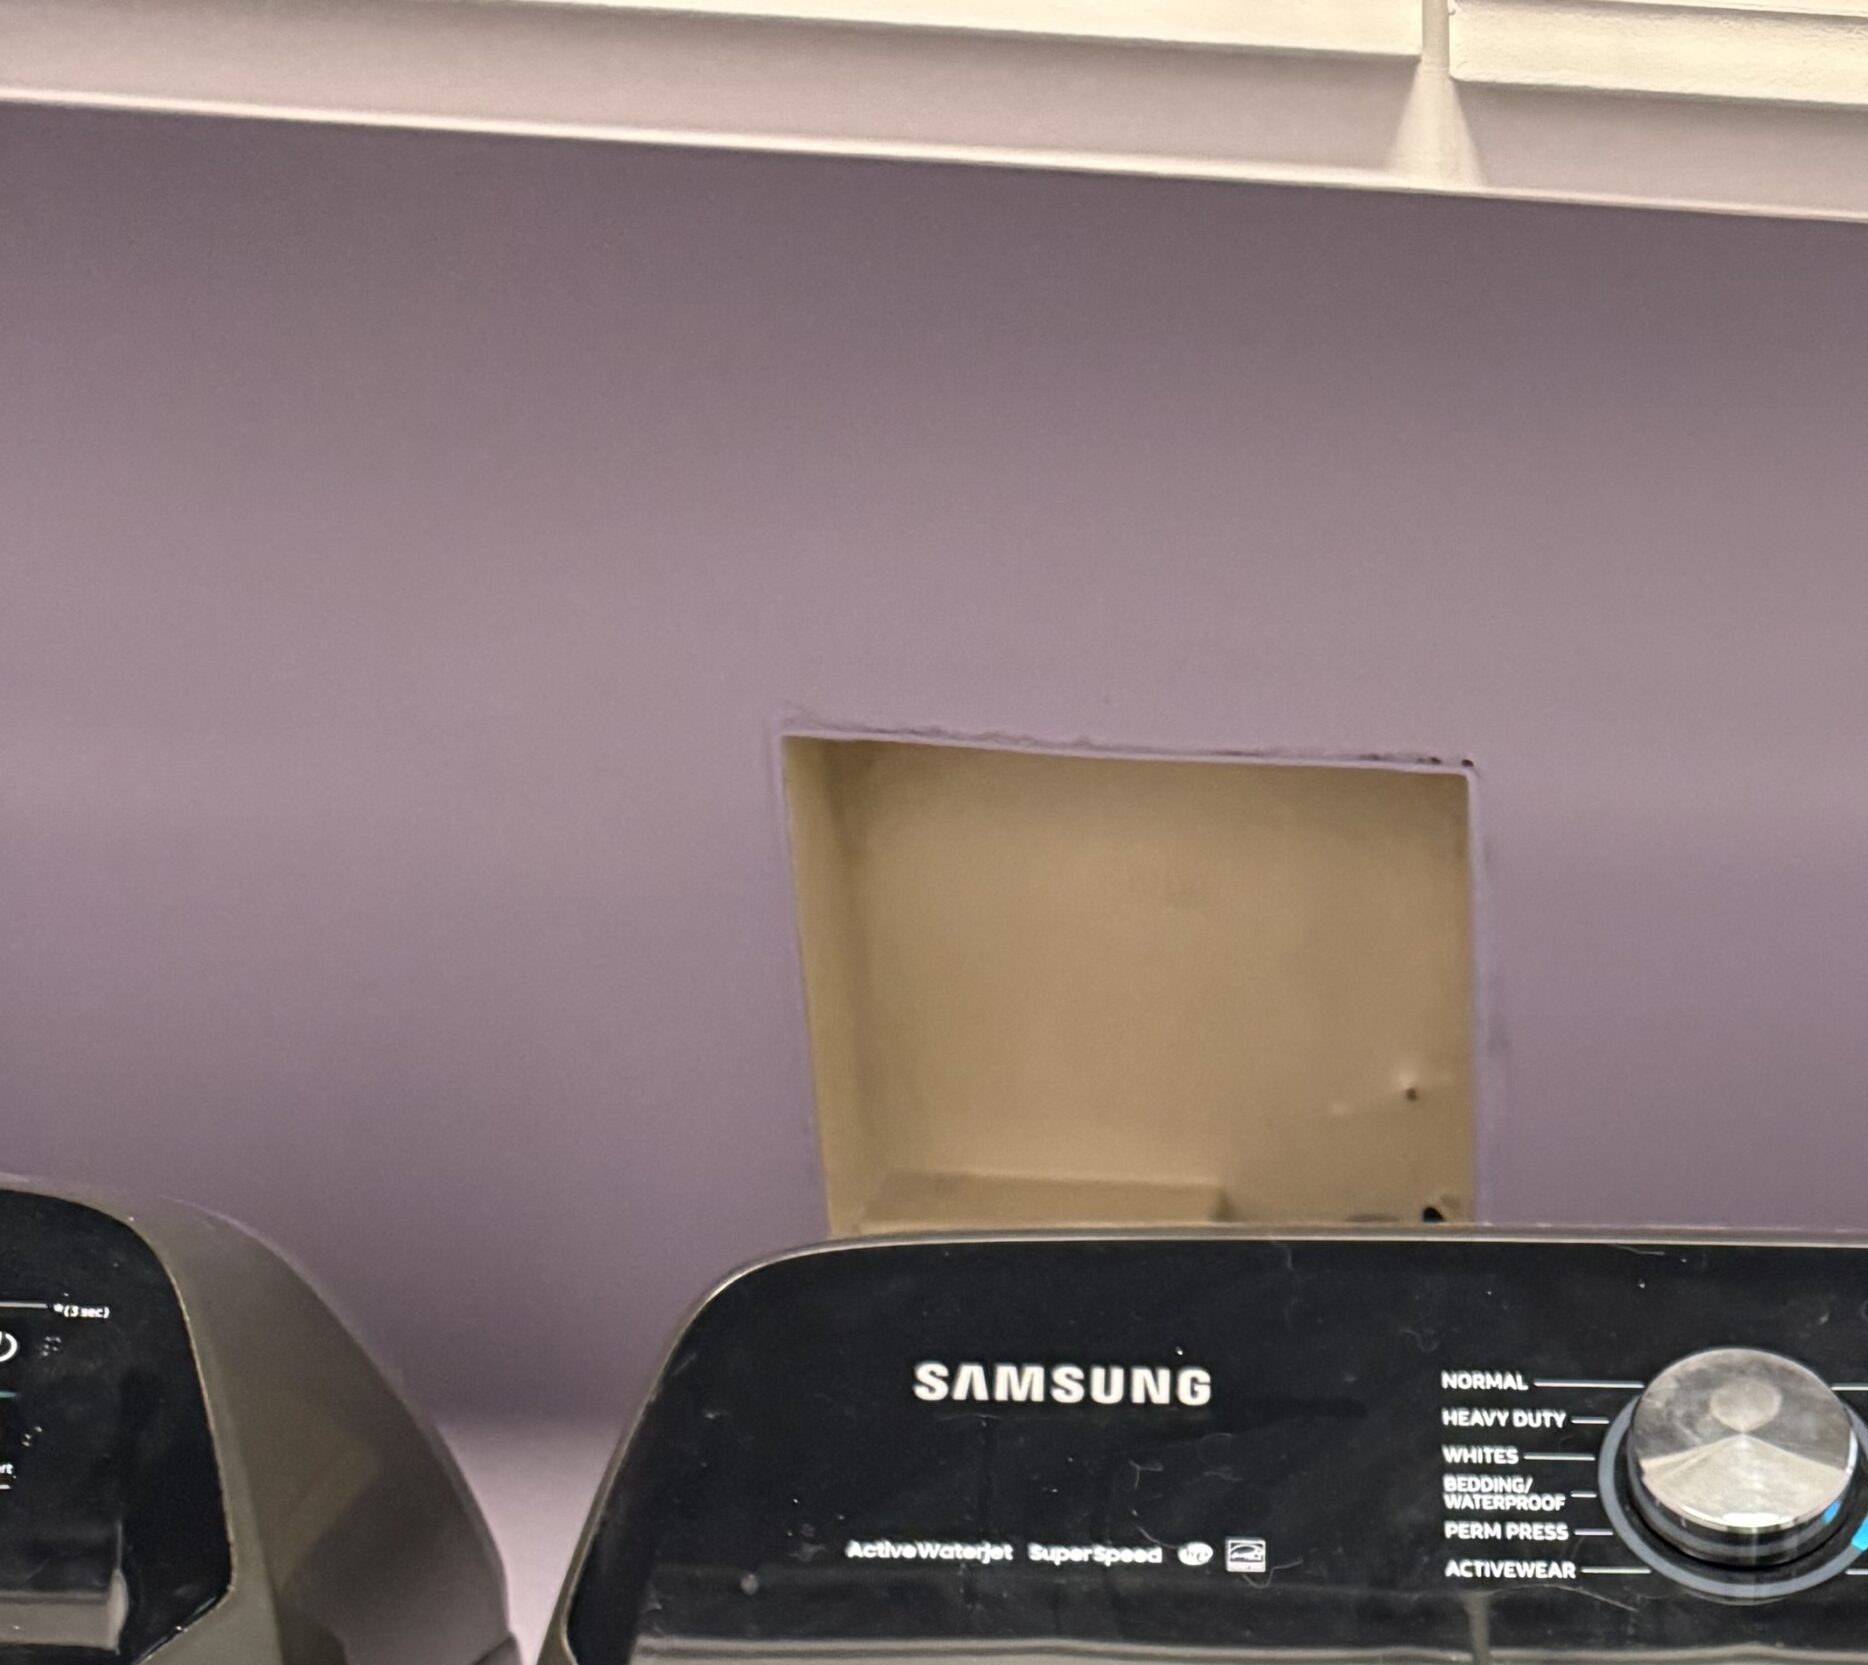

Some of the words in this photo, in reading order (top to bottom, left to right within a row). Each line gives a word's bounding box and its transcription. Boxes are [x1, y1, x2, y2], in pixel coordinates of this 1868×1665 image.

[913, 1360, 1212, 1406] SAMSUNG
[1441, 1371, 1528, 1391] NORMAL
[1442, 1410, 1508, 1430] HEAVY
[1512, 1410, 1566, 1431] DUTY
[1443, 1447, 1519, 1465] WHITES
[1443, 1475, 1533, 1495] BEDDING/
[1444, 1493, 1566, 1512] WATERPROOF
[1445, 1523, 1499, 1541] PERM
[1503, 1523, 1568, 1542] PRESS
[1445, 1562, 1576, 1580] ACTIVEWEAR
